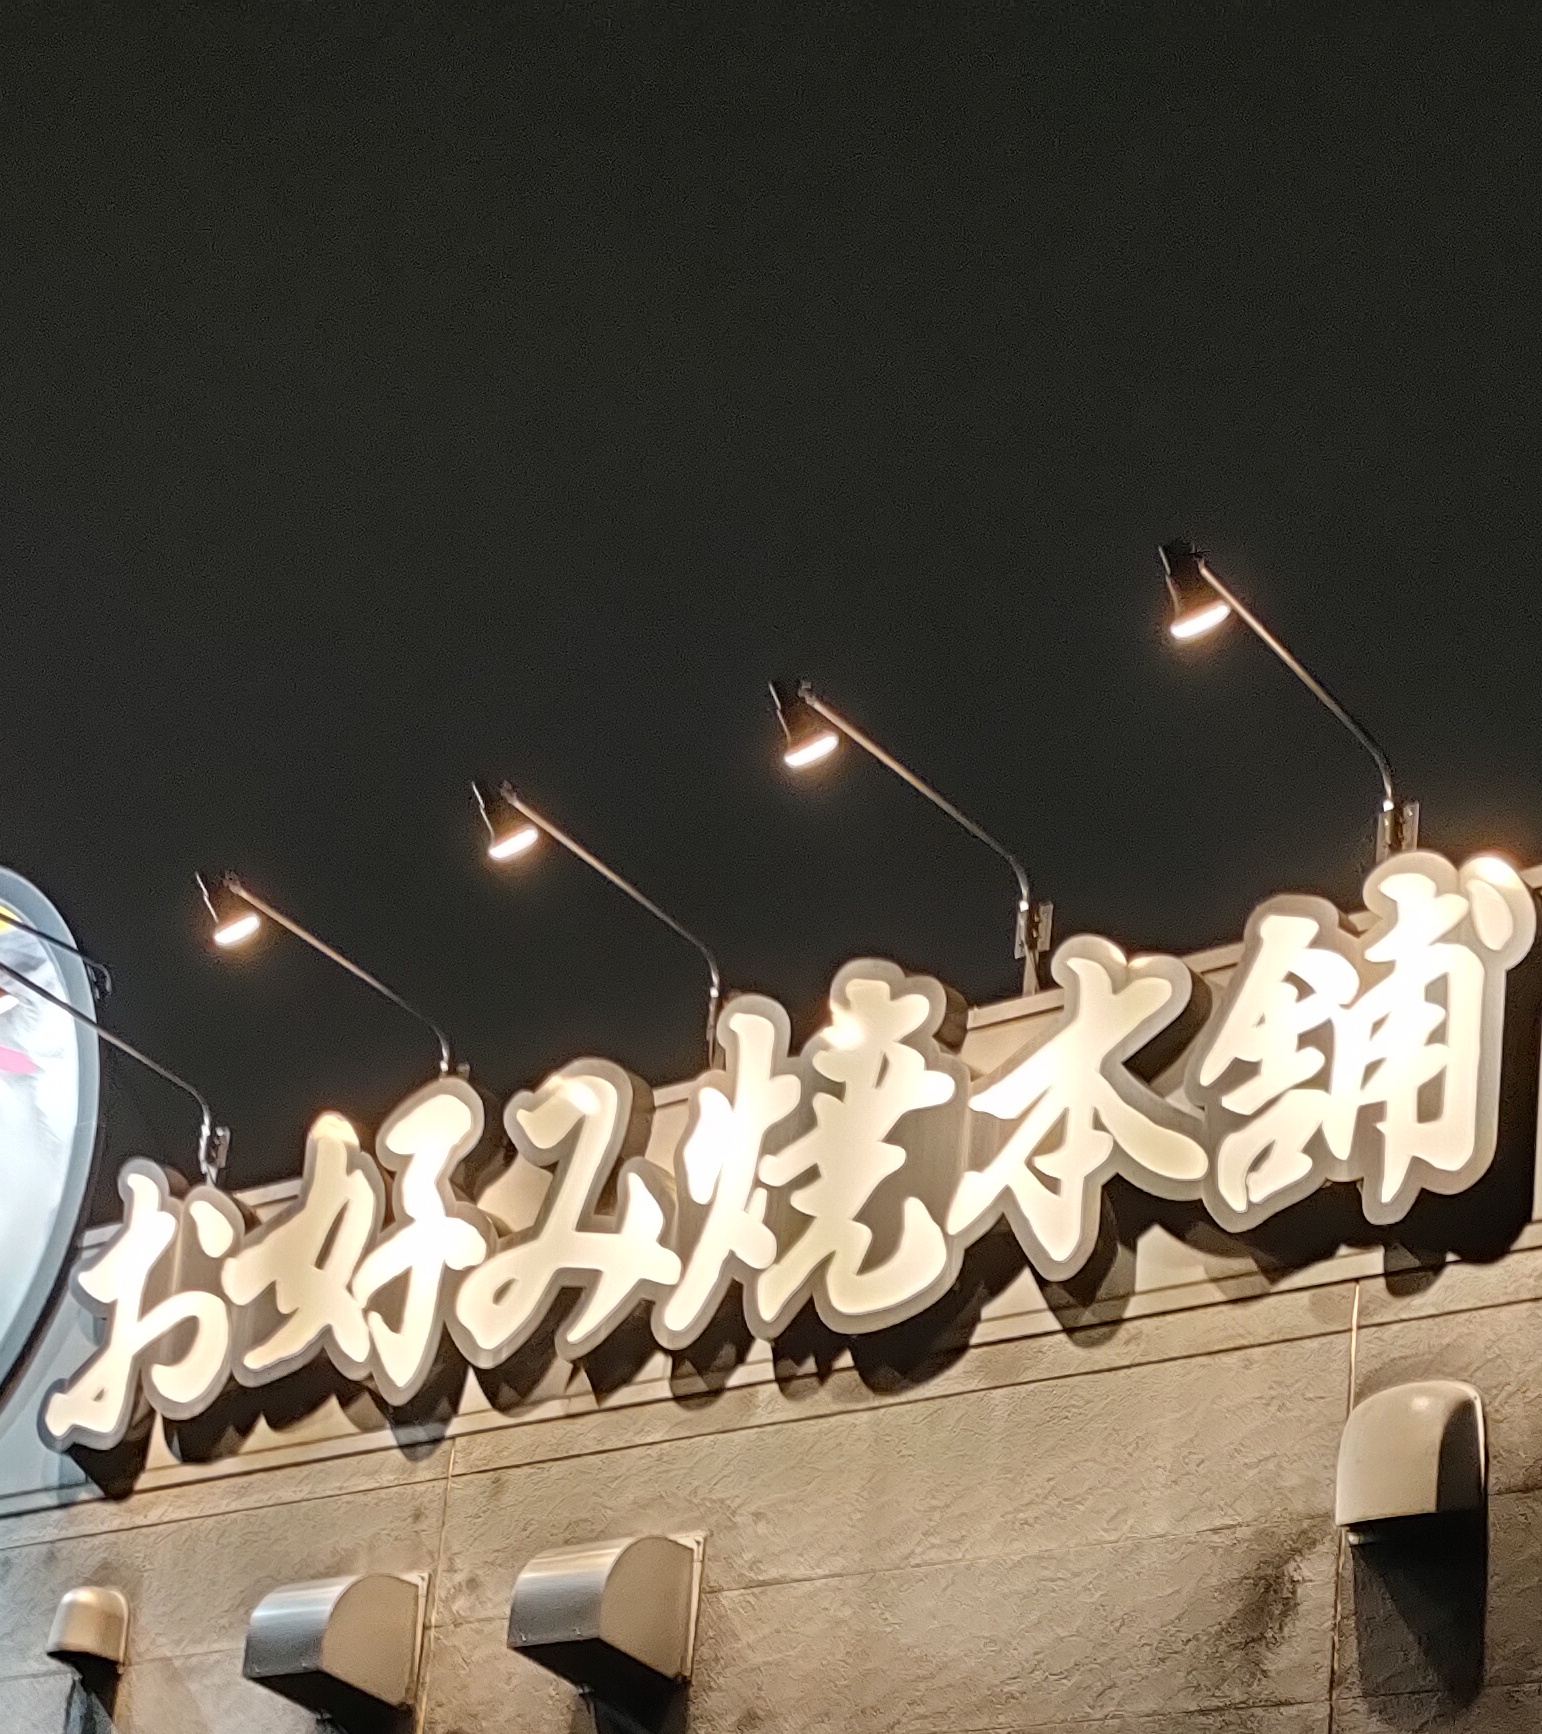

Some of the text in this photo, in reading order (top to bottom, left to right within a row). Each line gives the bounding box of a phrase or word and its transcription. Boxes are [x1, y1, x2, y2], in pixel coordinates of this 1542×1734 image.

[42, 860, 1521, 1440] お好み焼本舗
